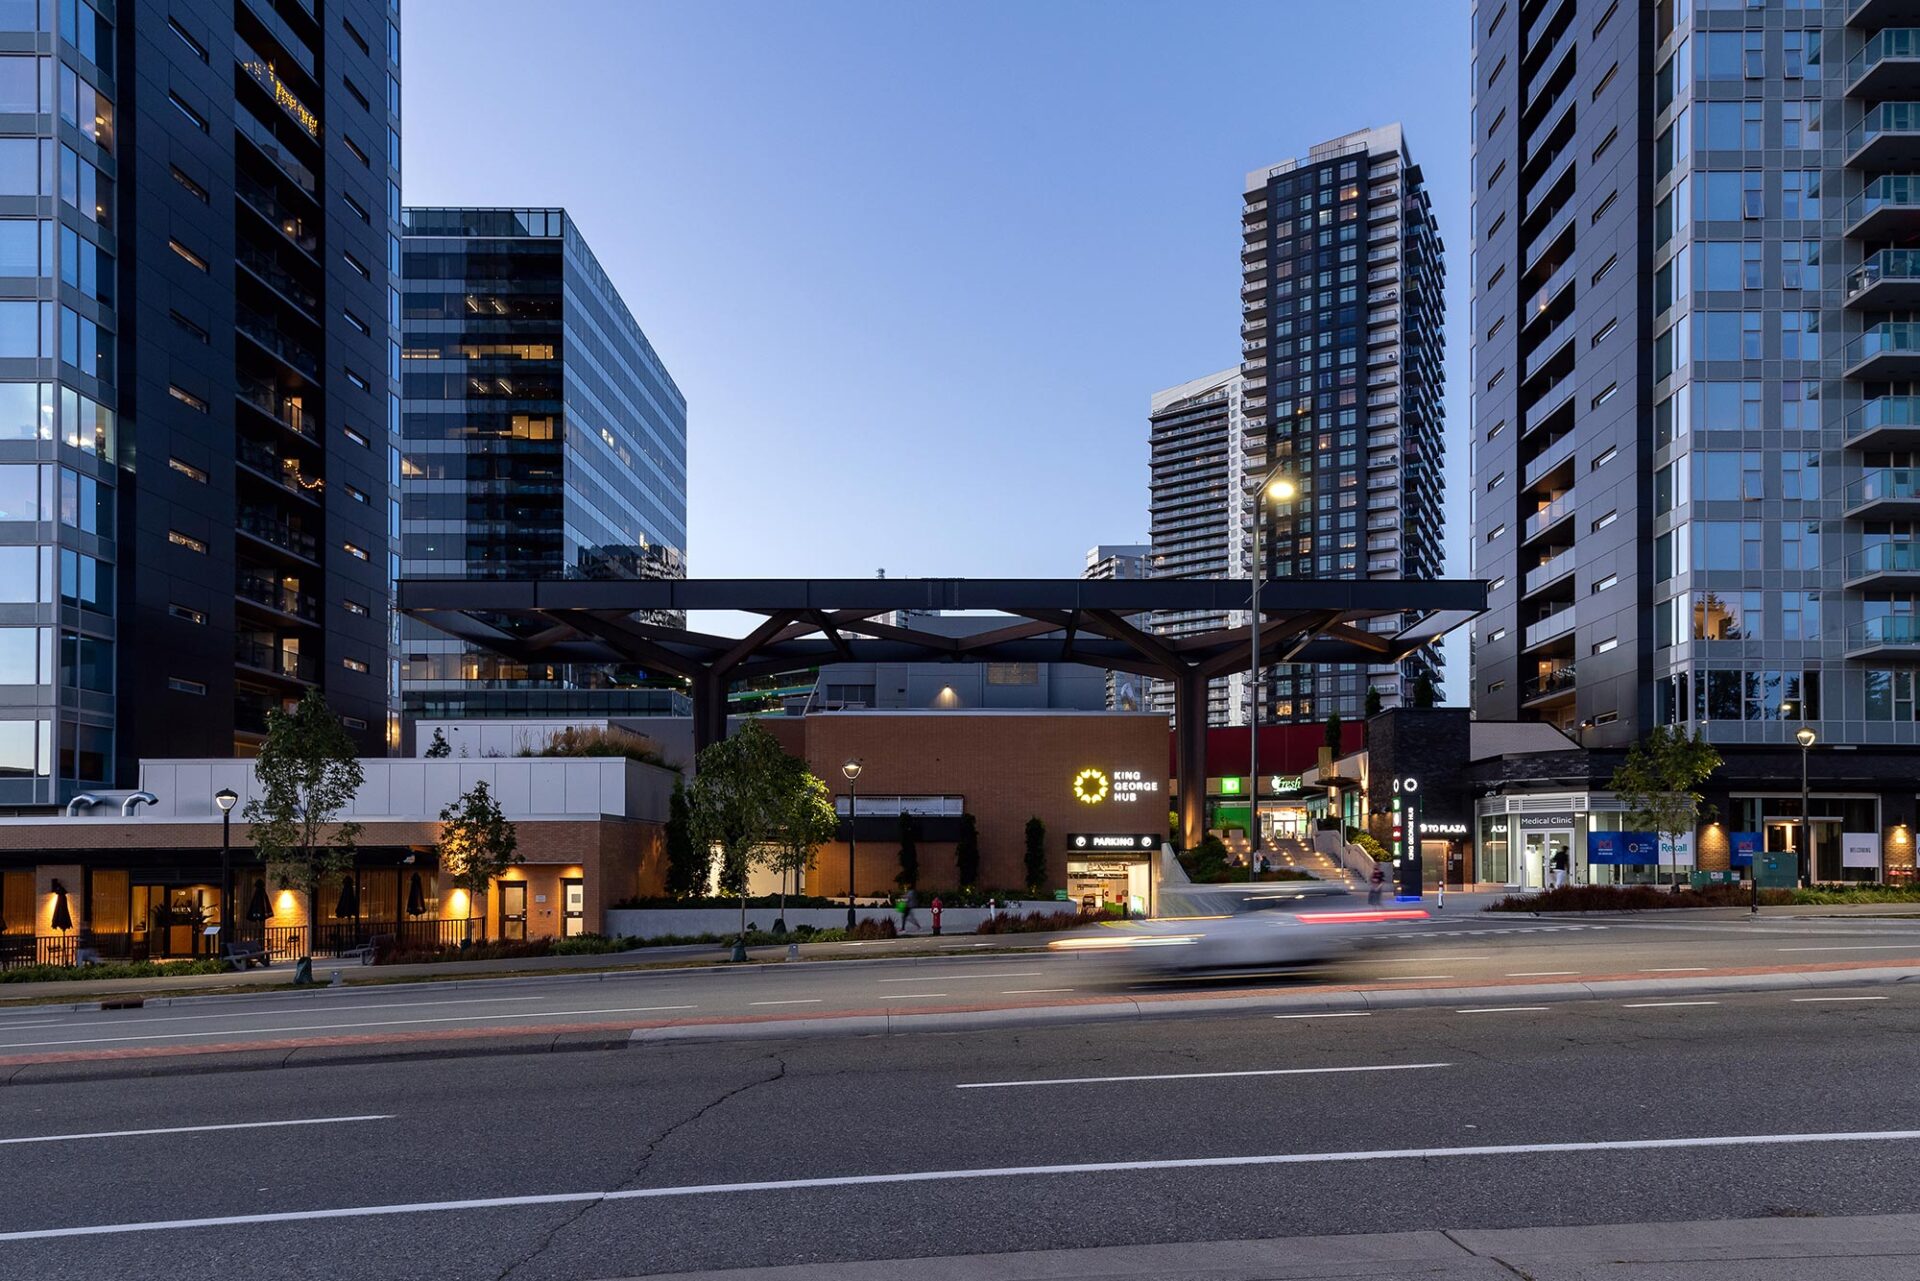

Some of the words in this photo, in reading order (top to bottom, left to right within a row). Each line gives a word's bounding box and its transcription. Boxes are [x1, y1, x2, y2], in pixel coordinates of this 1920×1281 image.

[1114, 771, 1140, 780] KING
[1114, 782, 1158, 791] GEORGE
[1114, 792, 1137, 802] HUB
[1521, 817, 1550, 825] Medical
[1551, 816, 1573, 825] Clinic
[1427, 824, 1439, 833] TO
[1440, 824, 1467, 833] PLAZA
[1093, 837, 1134, 846] PARKING
